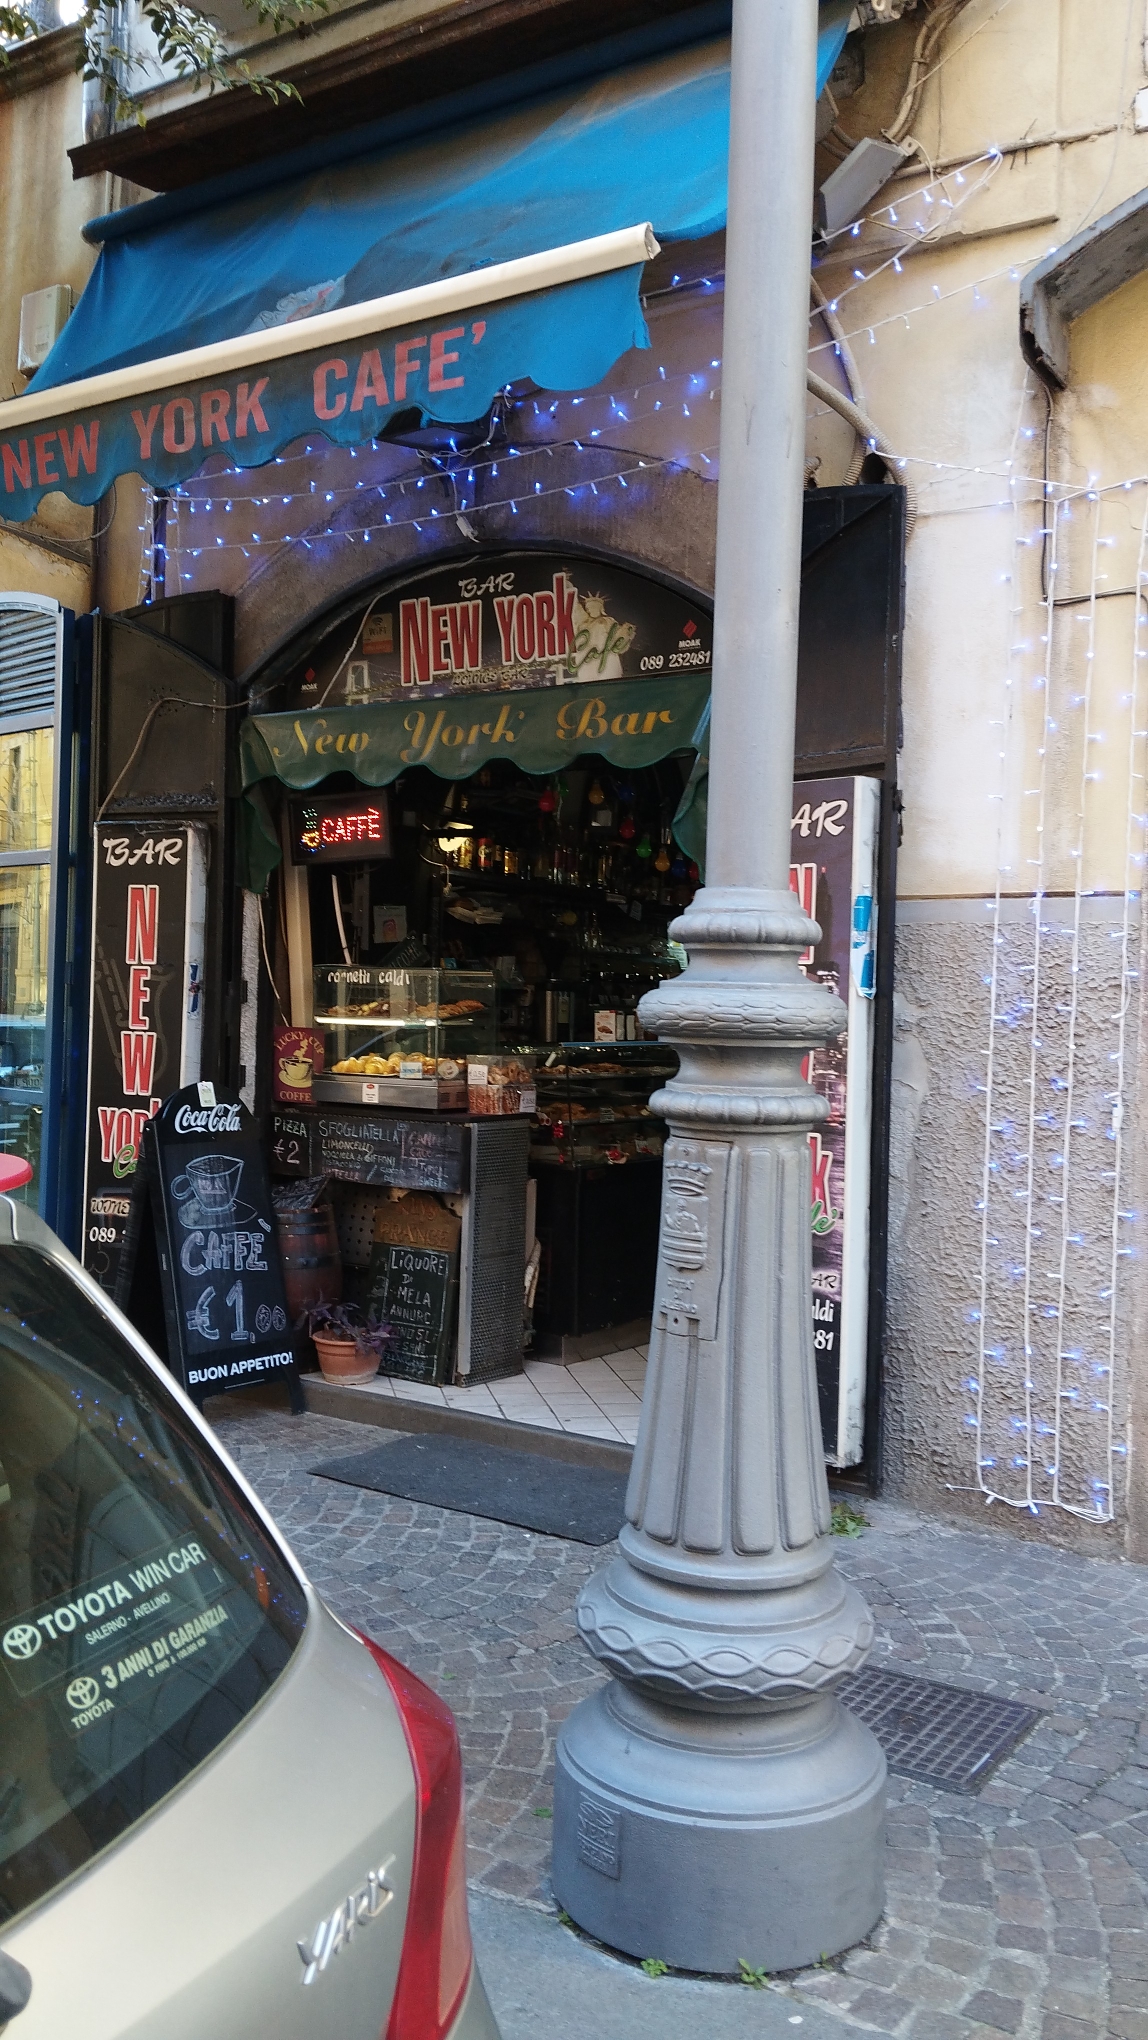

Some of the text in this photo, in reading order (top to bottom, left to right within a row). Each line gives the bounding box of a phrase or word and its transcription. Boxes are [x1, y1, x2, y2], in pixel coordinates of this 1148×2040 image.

[1, 421, 100, 494] NEW
[131, 377, 271, 460] YORK
[459, 572, 515, 598] BAR
[400, 572, 579, 687] NEW YORK
[640, 650, 711, 671] 089 232481
[273, 696, 675, 765] New York Bar
[791, 799, 849, 838] AR
[102, 837, 184, 868] BAR
[121, 884, 160, 1096] NEW
[378, 968, 411, 987] caldi
[274, 1030, 325, 1055] LUCKY CUP
[279, 1090, 312, 1102] COFFE
[98, 1097, 162, 1164] YOR
[174, 1103, 243, 1135] Coca-Cola
[89, 1226, 117, 1243] 089
[397, 1286, 432, 1308] MELA
[811, 1273, 838, 1289] AR
[189, 1351, 294, 1385] BUON APPETITO!
[37, 1542, 207, 1640] TOYOTA WIN CAR
[85, 1615, 129, 1646] SALERNO
[133, 1591, 171, 1621] AVELLINO
[101, 1604, 229, 1690] 3 ANNI DI GARANZIA
[71, 1698, 115, 1730] TOYOTA
